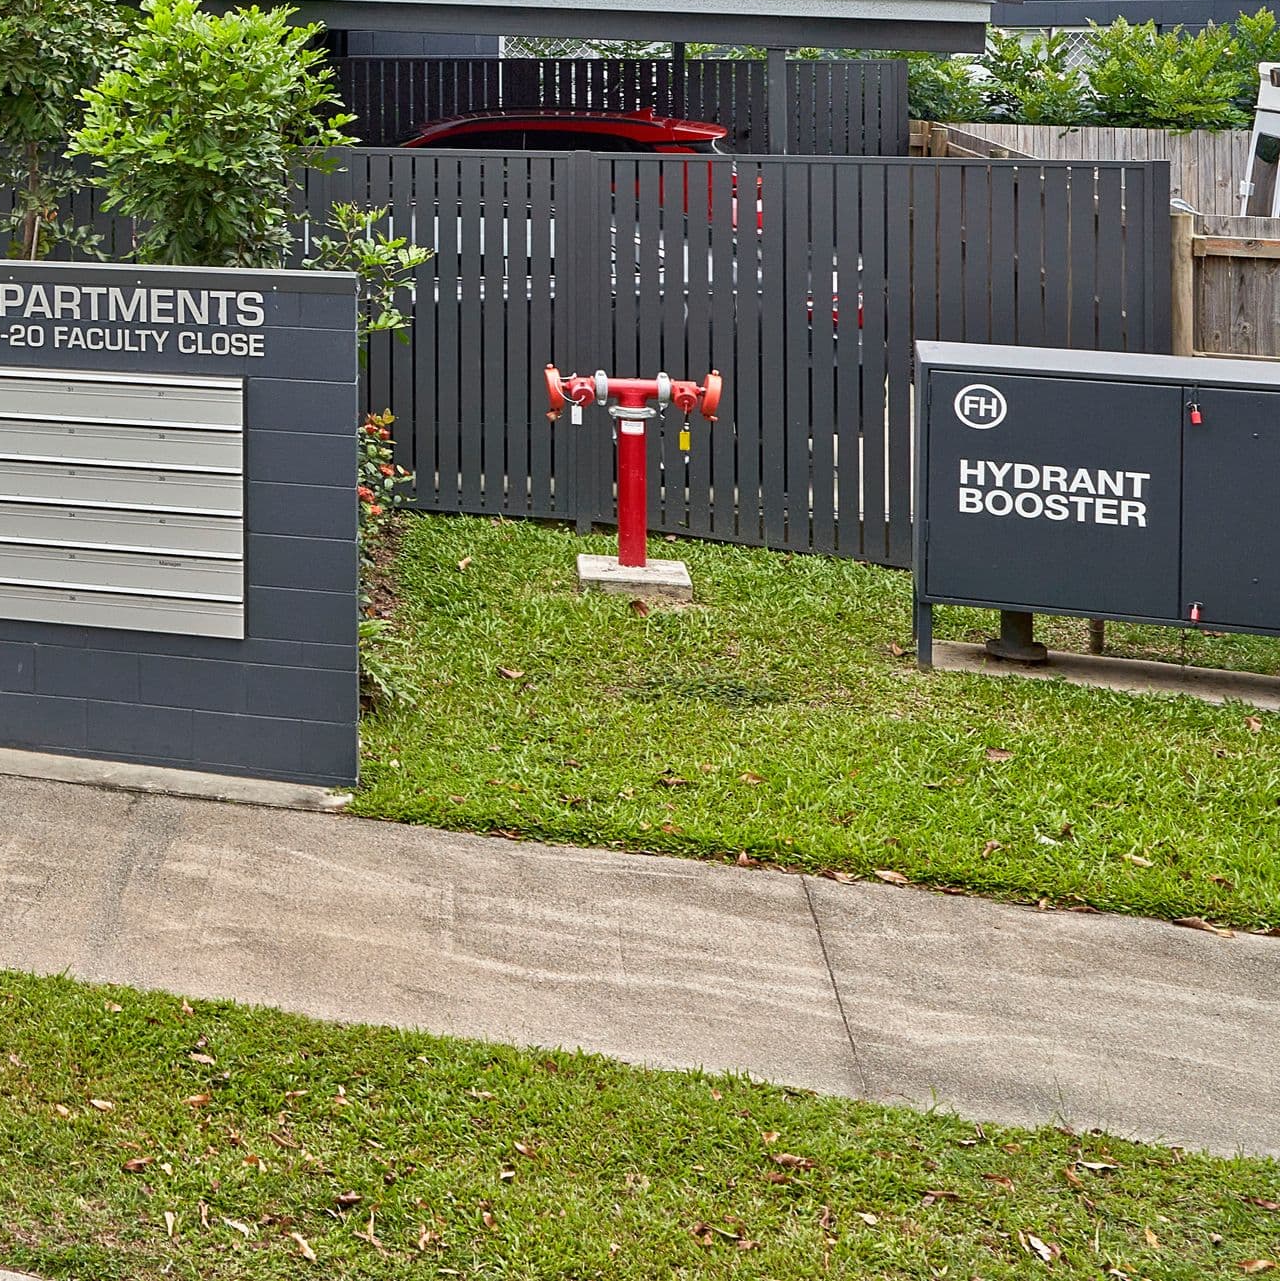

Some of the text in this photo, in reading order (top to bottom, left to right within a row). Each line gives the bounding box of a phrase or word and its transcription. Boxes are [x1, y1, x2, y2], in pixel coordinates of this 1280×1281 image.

[53, 326, 170, 353] FACULTY
[178, 332, 265, 357] CLOSE
[963, 395, 998, 418] FH
[959, 458, 1151, 498] HYDRANT
[959, 487, 1148, 528] BOOSTER
